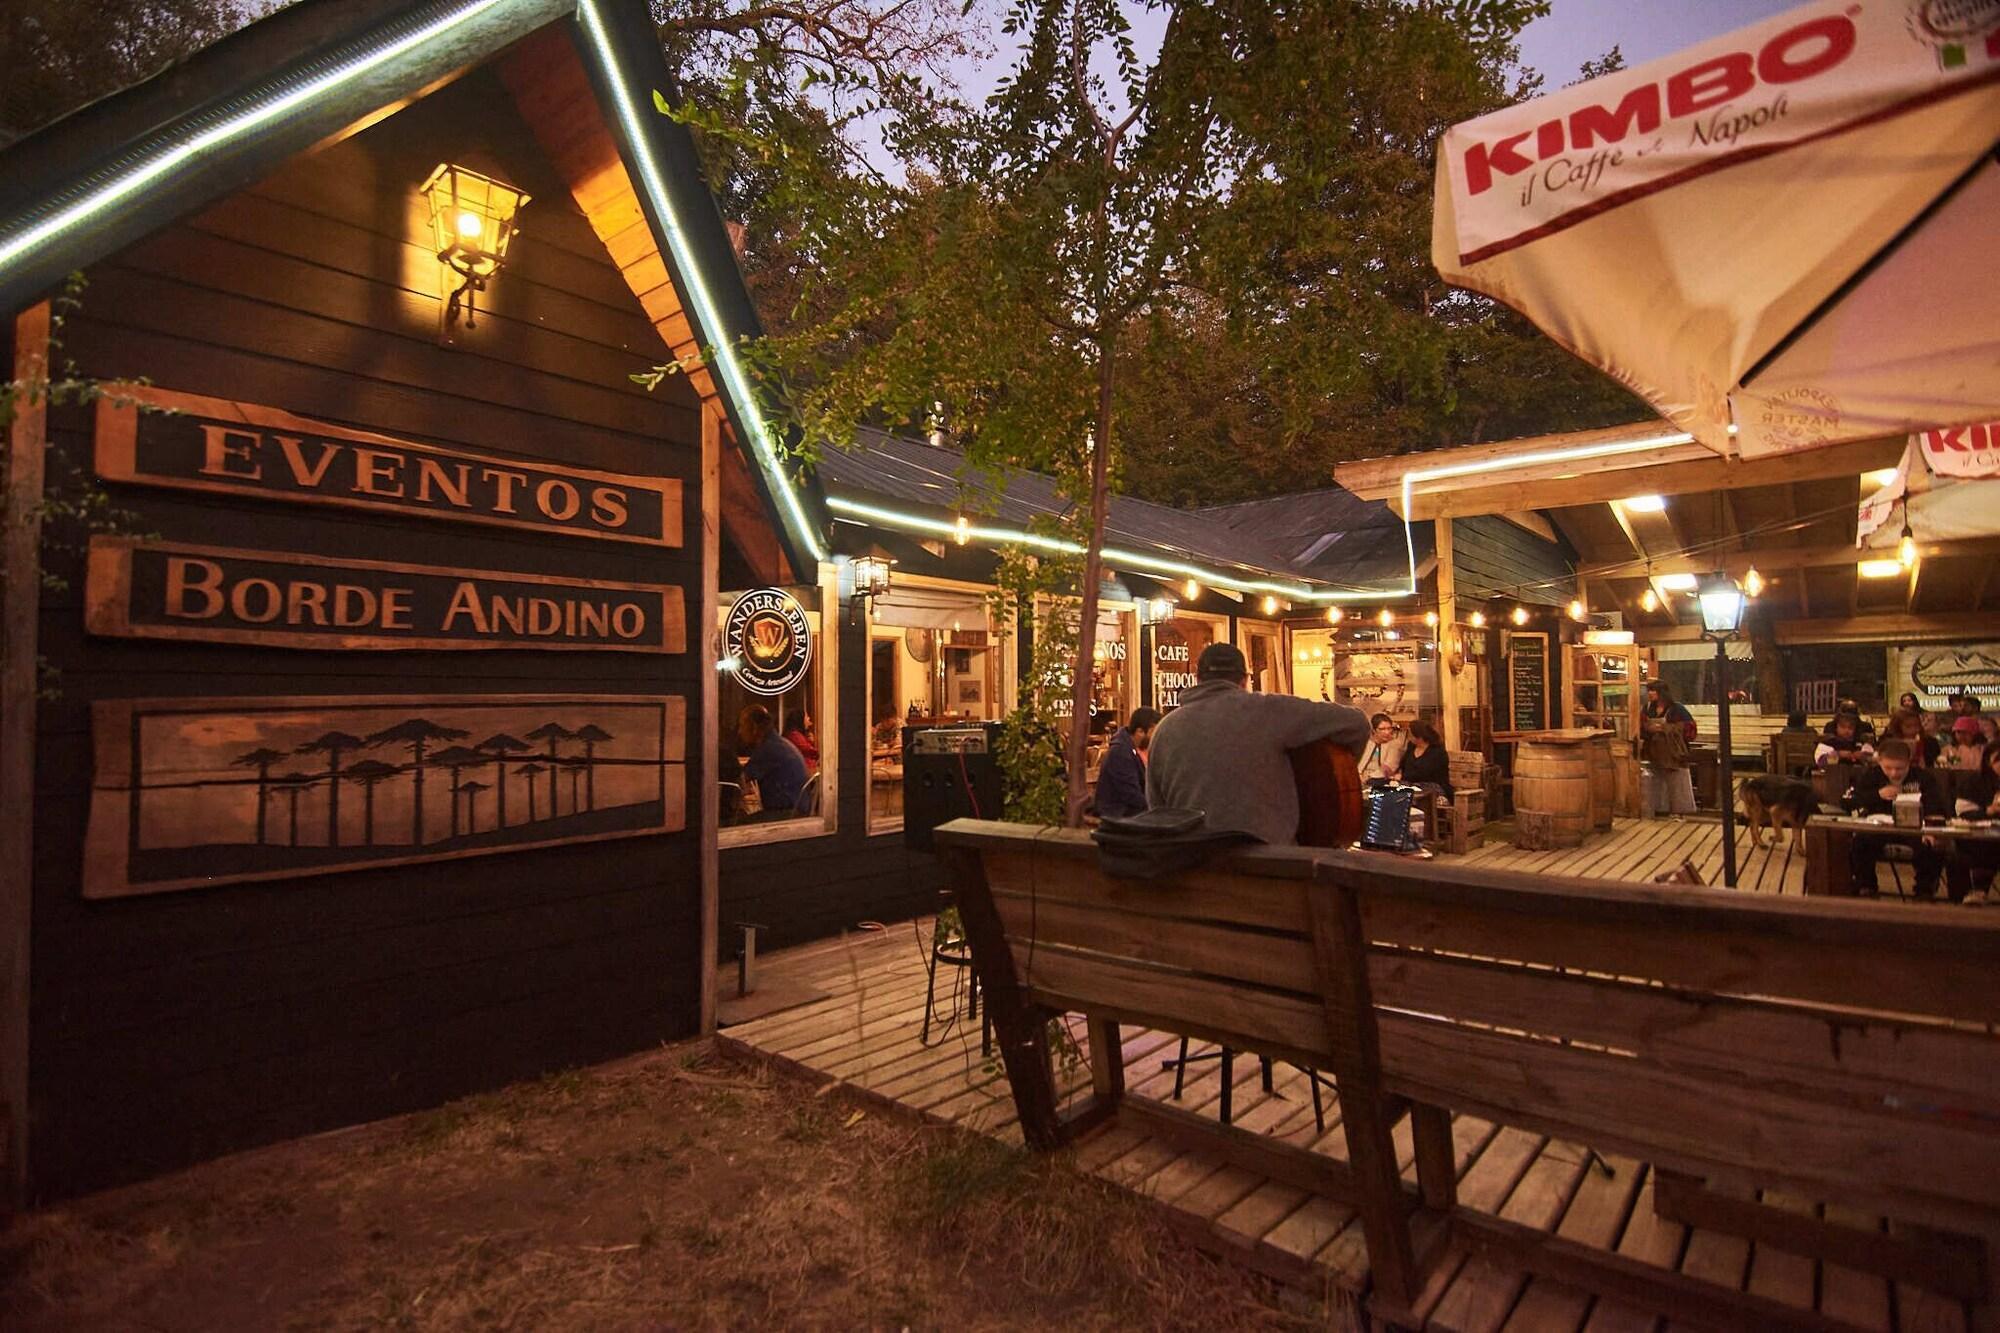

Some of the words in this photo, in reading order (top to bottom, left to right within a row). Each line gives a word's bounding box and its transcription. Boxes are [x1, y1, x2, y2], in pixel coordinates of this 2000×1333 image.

[1464, 14, 1857, 195] KIMBO
[1688, 91, 1789, 149] Napoli
[1928, 424, 2000, 452] KI
[199, 424, 628, 527] EVENTOS
[165, 558, 414, 630] BORDE
[440, 582, 645, 639] ANDINO
[729, 595, 807, 661] WANDERSLEBEN
[1158, 642, 1189, 661] CAFÉ
